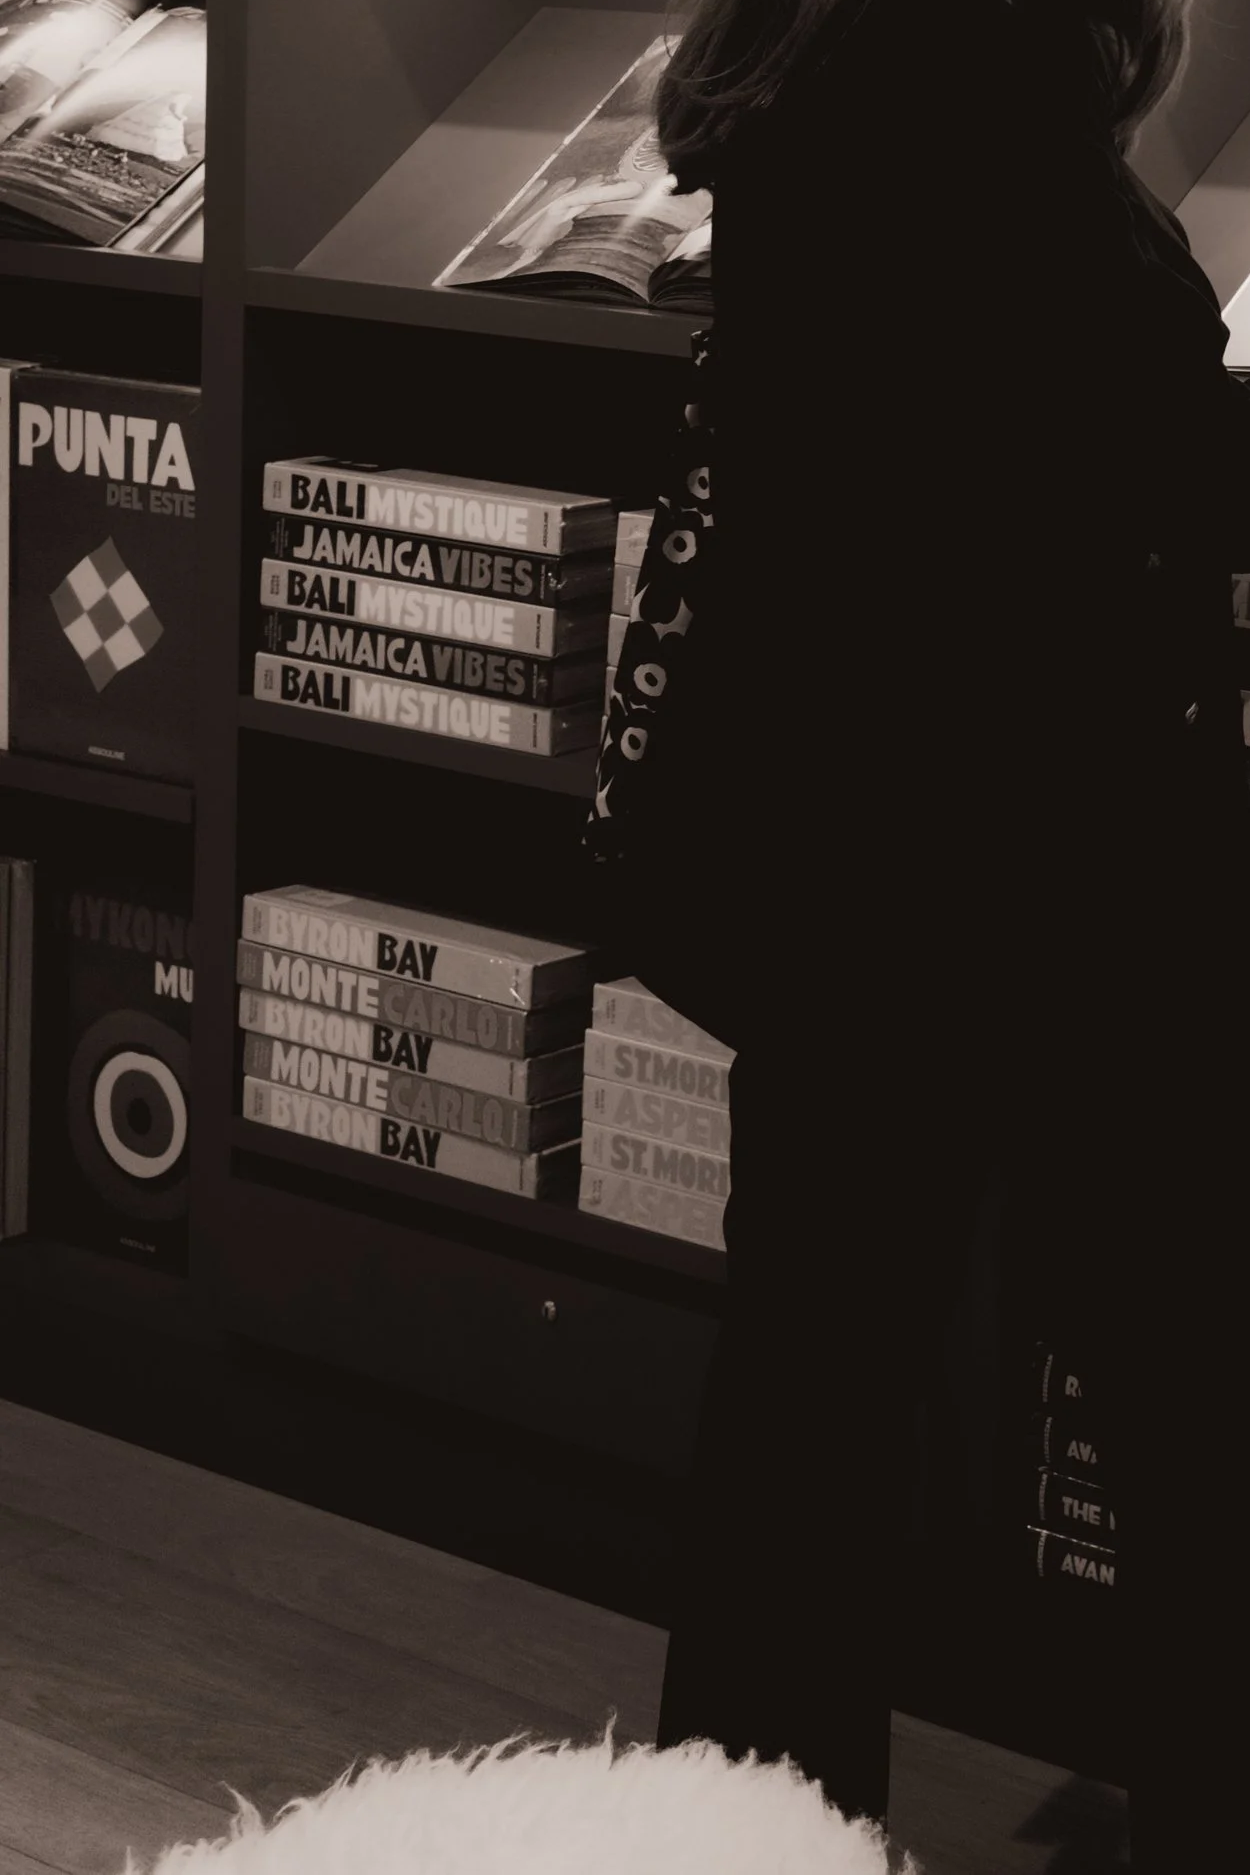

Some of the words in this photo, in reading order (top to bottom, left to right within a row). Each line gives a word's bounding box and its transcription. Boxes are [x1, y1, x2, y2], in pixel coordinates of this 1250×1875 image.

[17, 401, 197, 491] PUNTA
[106, 482, 144, 512] DEL
[148, 488, 197, 519] ESTE
[289, 473, 366, 520] BALI
[367, 484, 529, 546] MYSTIQUE
[293, 525, 435, 582] JAMAICA
[438, 552, 534, 597] VIBES
[280, 664, 351, 713] BALI
[353, 678, 512, 745] MYSTIQUE
[268, 905, 374, 962] BYRON
[376, 932, 439, 982] BAY
[261, 950, 380, 1018] MONTE
[382, 981, 499, 1050] CARLO
[610, 1135, 648, 1175] ST.
[1062, 1495, 1101, 1526] THE
